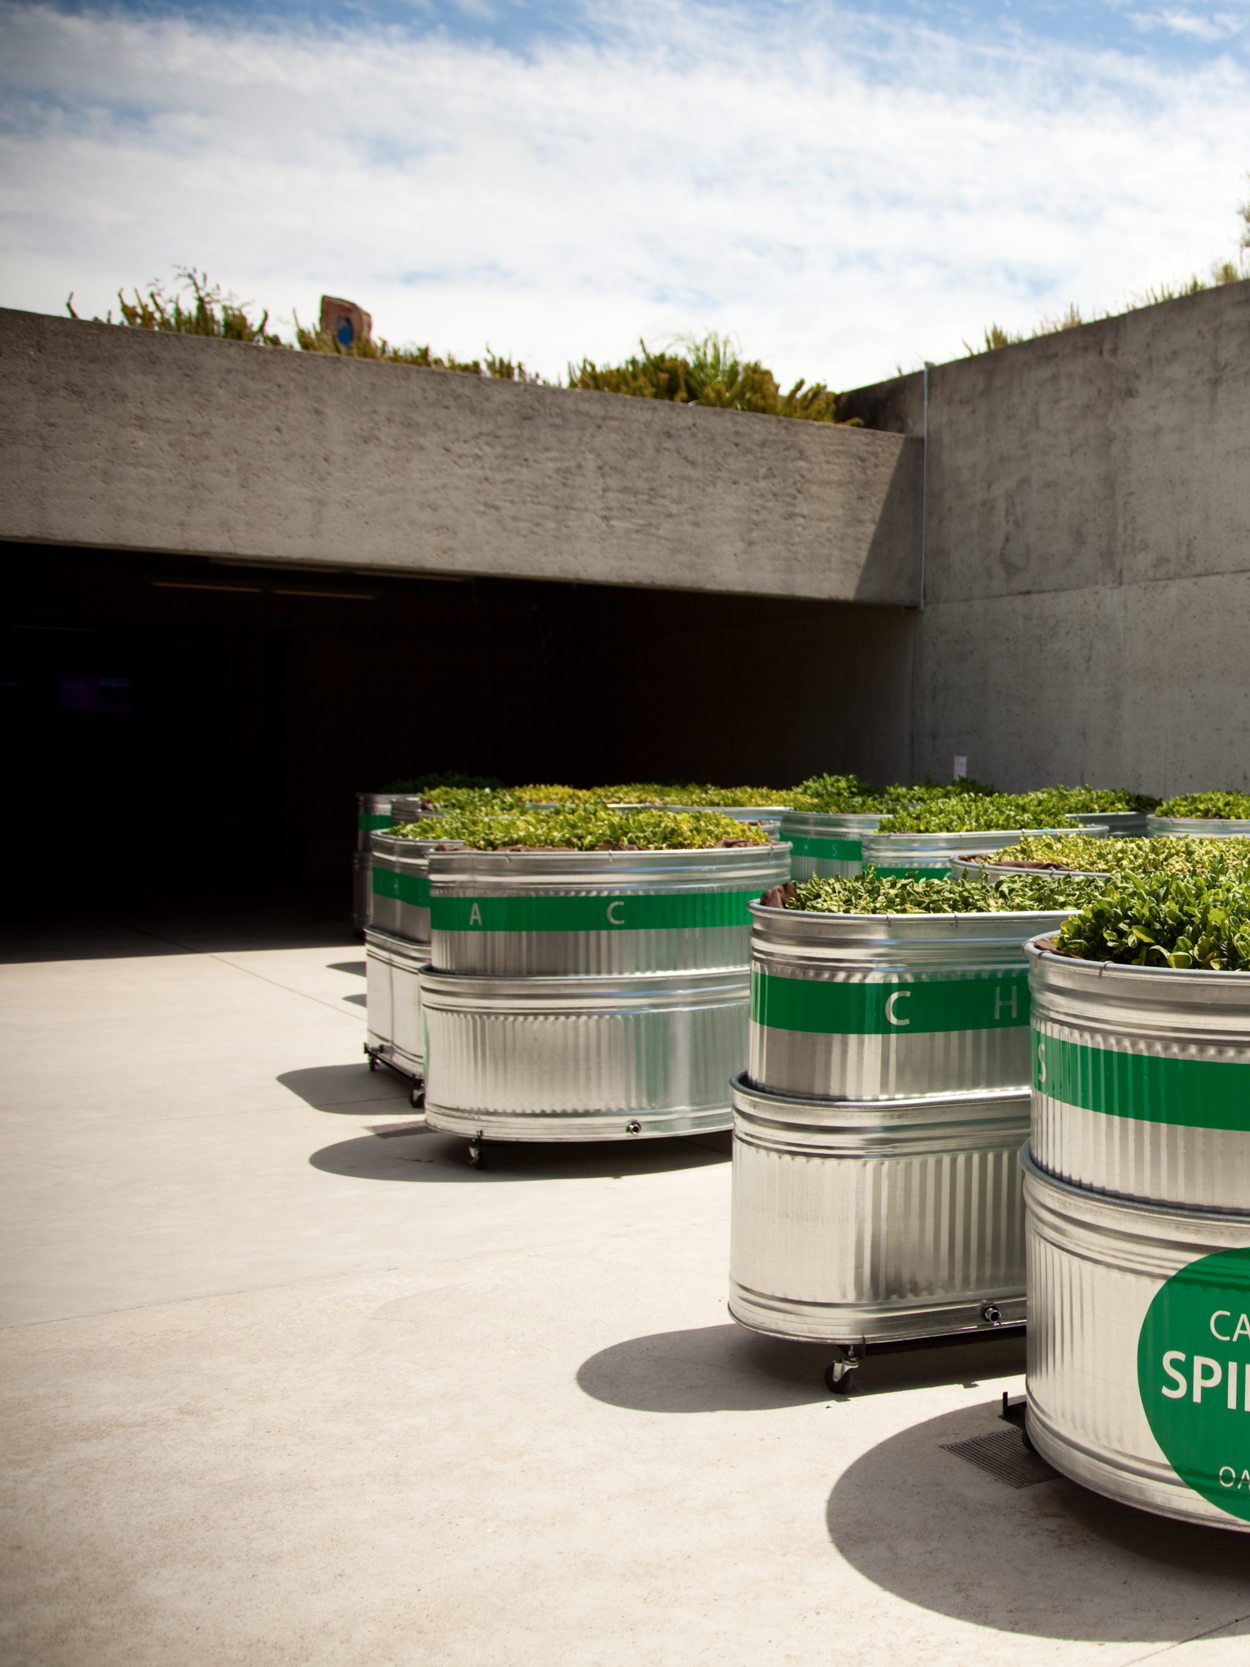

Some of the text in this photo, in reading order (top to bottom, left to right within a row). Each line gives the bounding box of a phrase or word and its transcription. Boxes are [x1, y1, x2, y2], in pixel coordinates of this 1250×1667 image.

[469, 901, 625, 925] A C
[885, 985, 1018, 1026] C H
[1038, 1043, 1046, 1083] S
